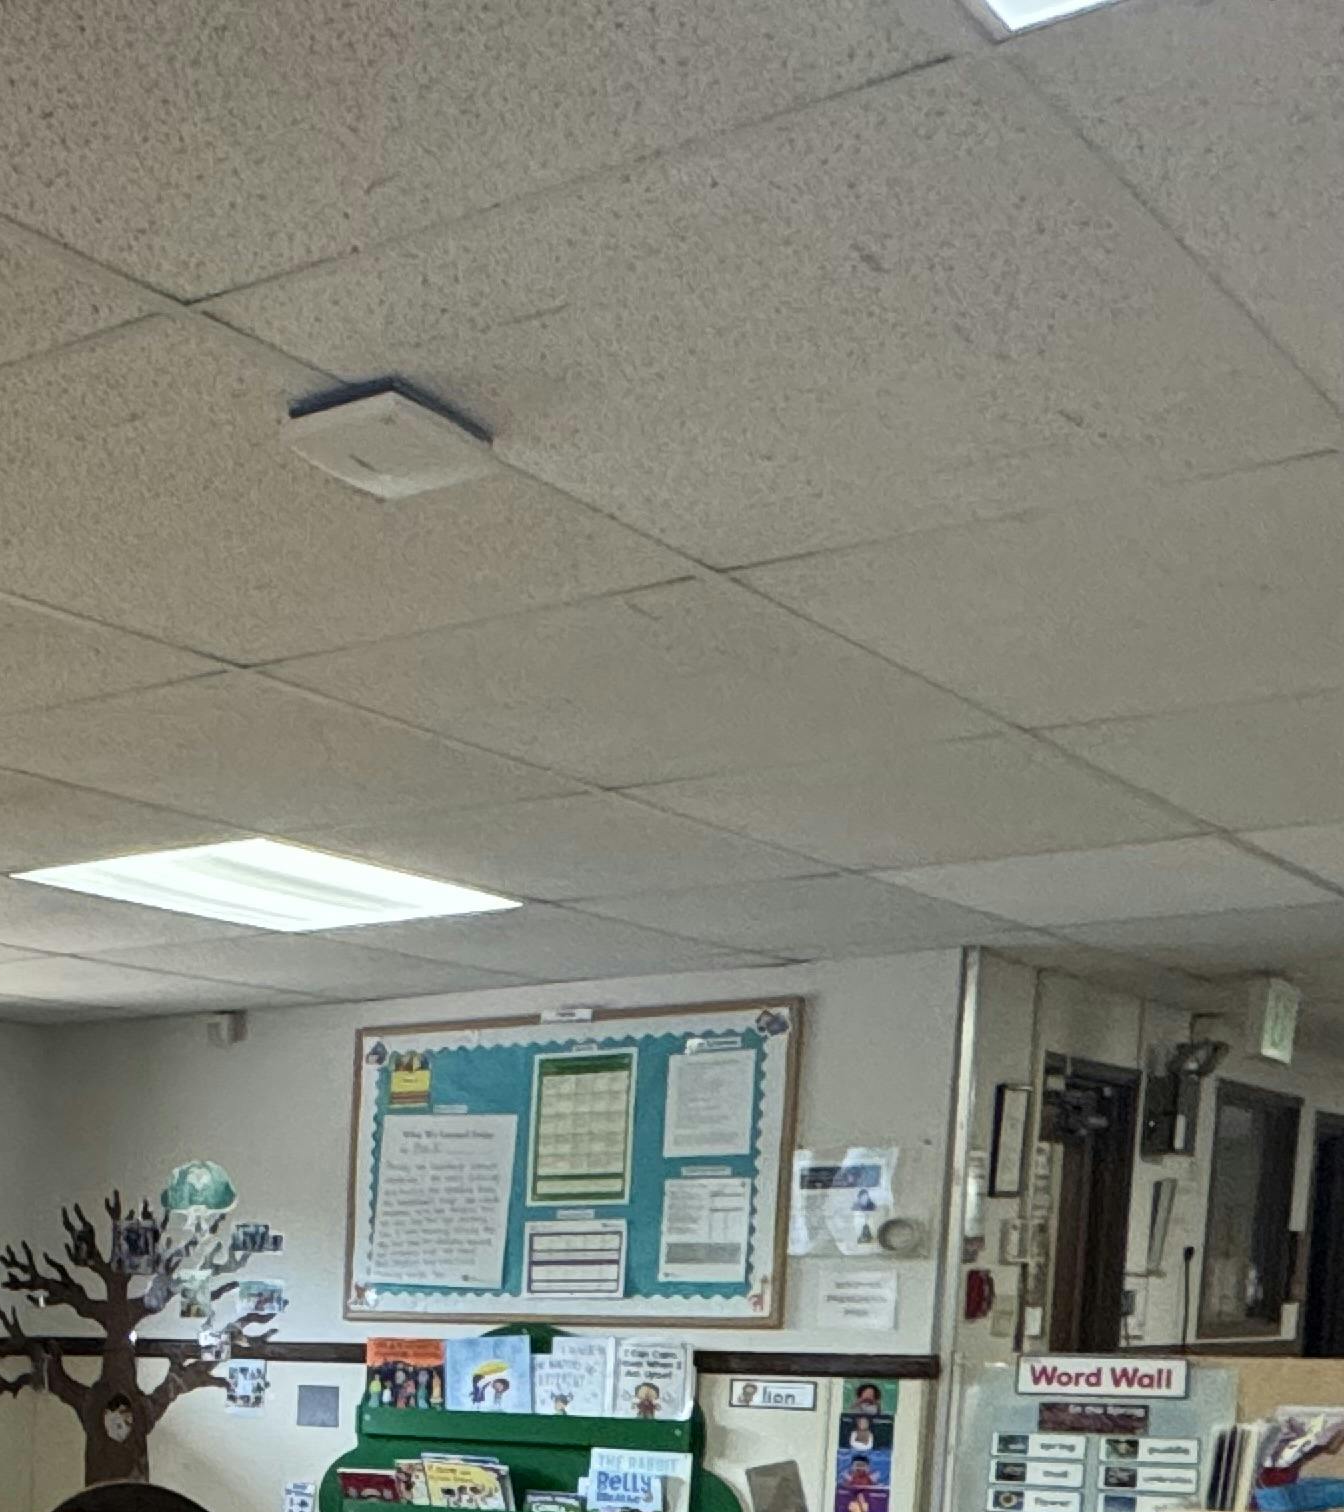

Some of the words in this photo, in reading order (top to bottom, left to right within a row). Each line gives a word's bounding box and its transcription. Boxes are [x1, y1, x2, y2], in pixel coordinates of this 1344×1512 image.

[1030, 1364, 1102, 1388] Word
[1111, 1366, 1173, 1390] Wall
[762, 1386, 796, 1404] lion
[596, 1470, 652, 1493] Belly
